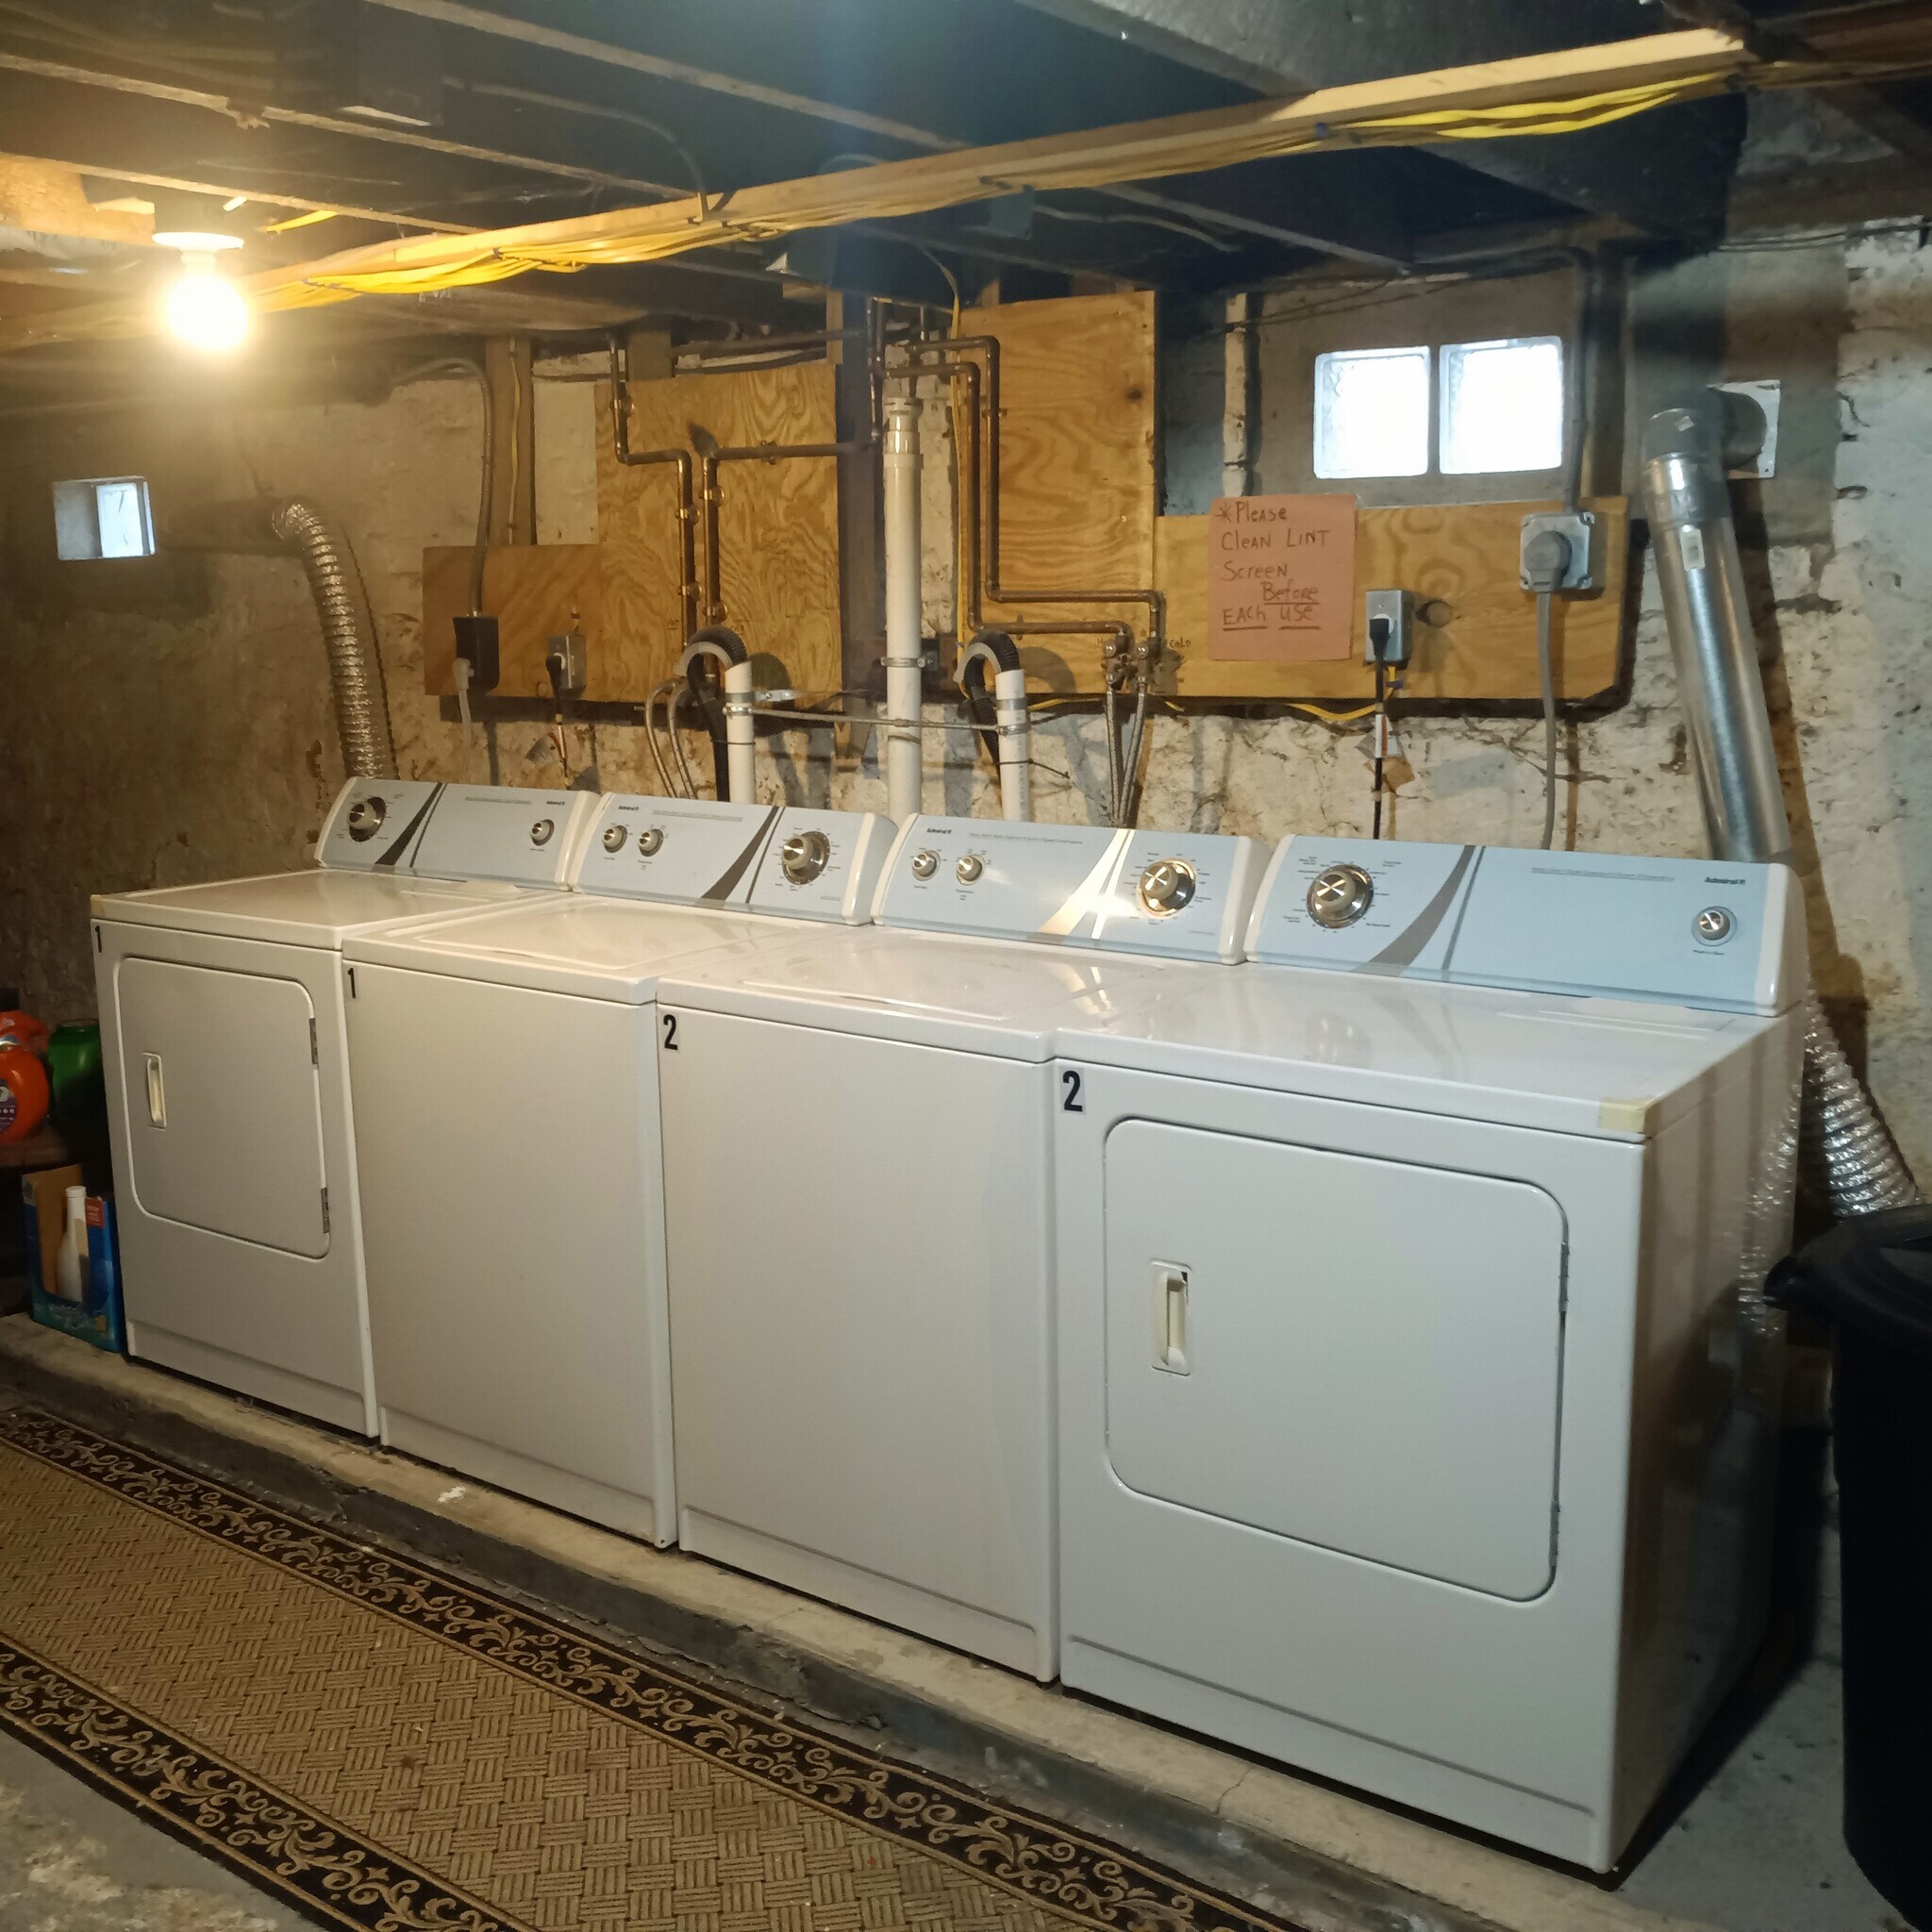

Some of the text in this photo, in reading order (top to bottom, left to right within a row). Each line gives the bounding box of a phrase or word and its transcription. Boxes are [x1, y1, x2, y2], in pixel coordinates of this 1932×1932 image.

[94, 924, 103, 953] 1
[347, 967, 357, 999] 1
[663, 1014, 678, 1051] 2
[1062, 1070, 1083, 1112] 2
